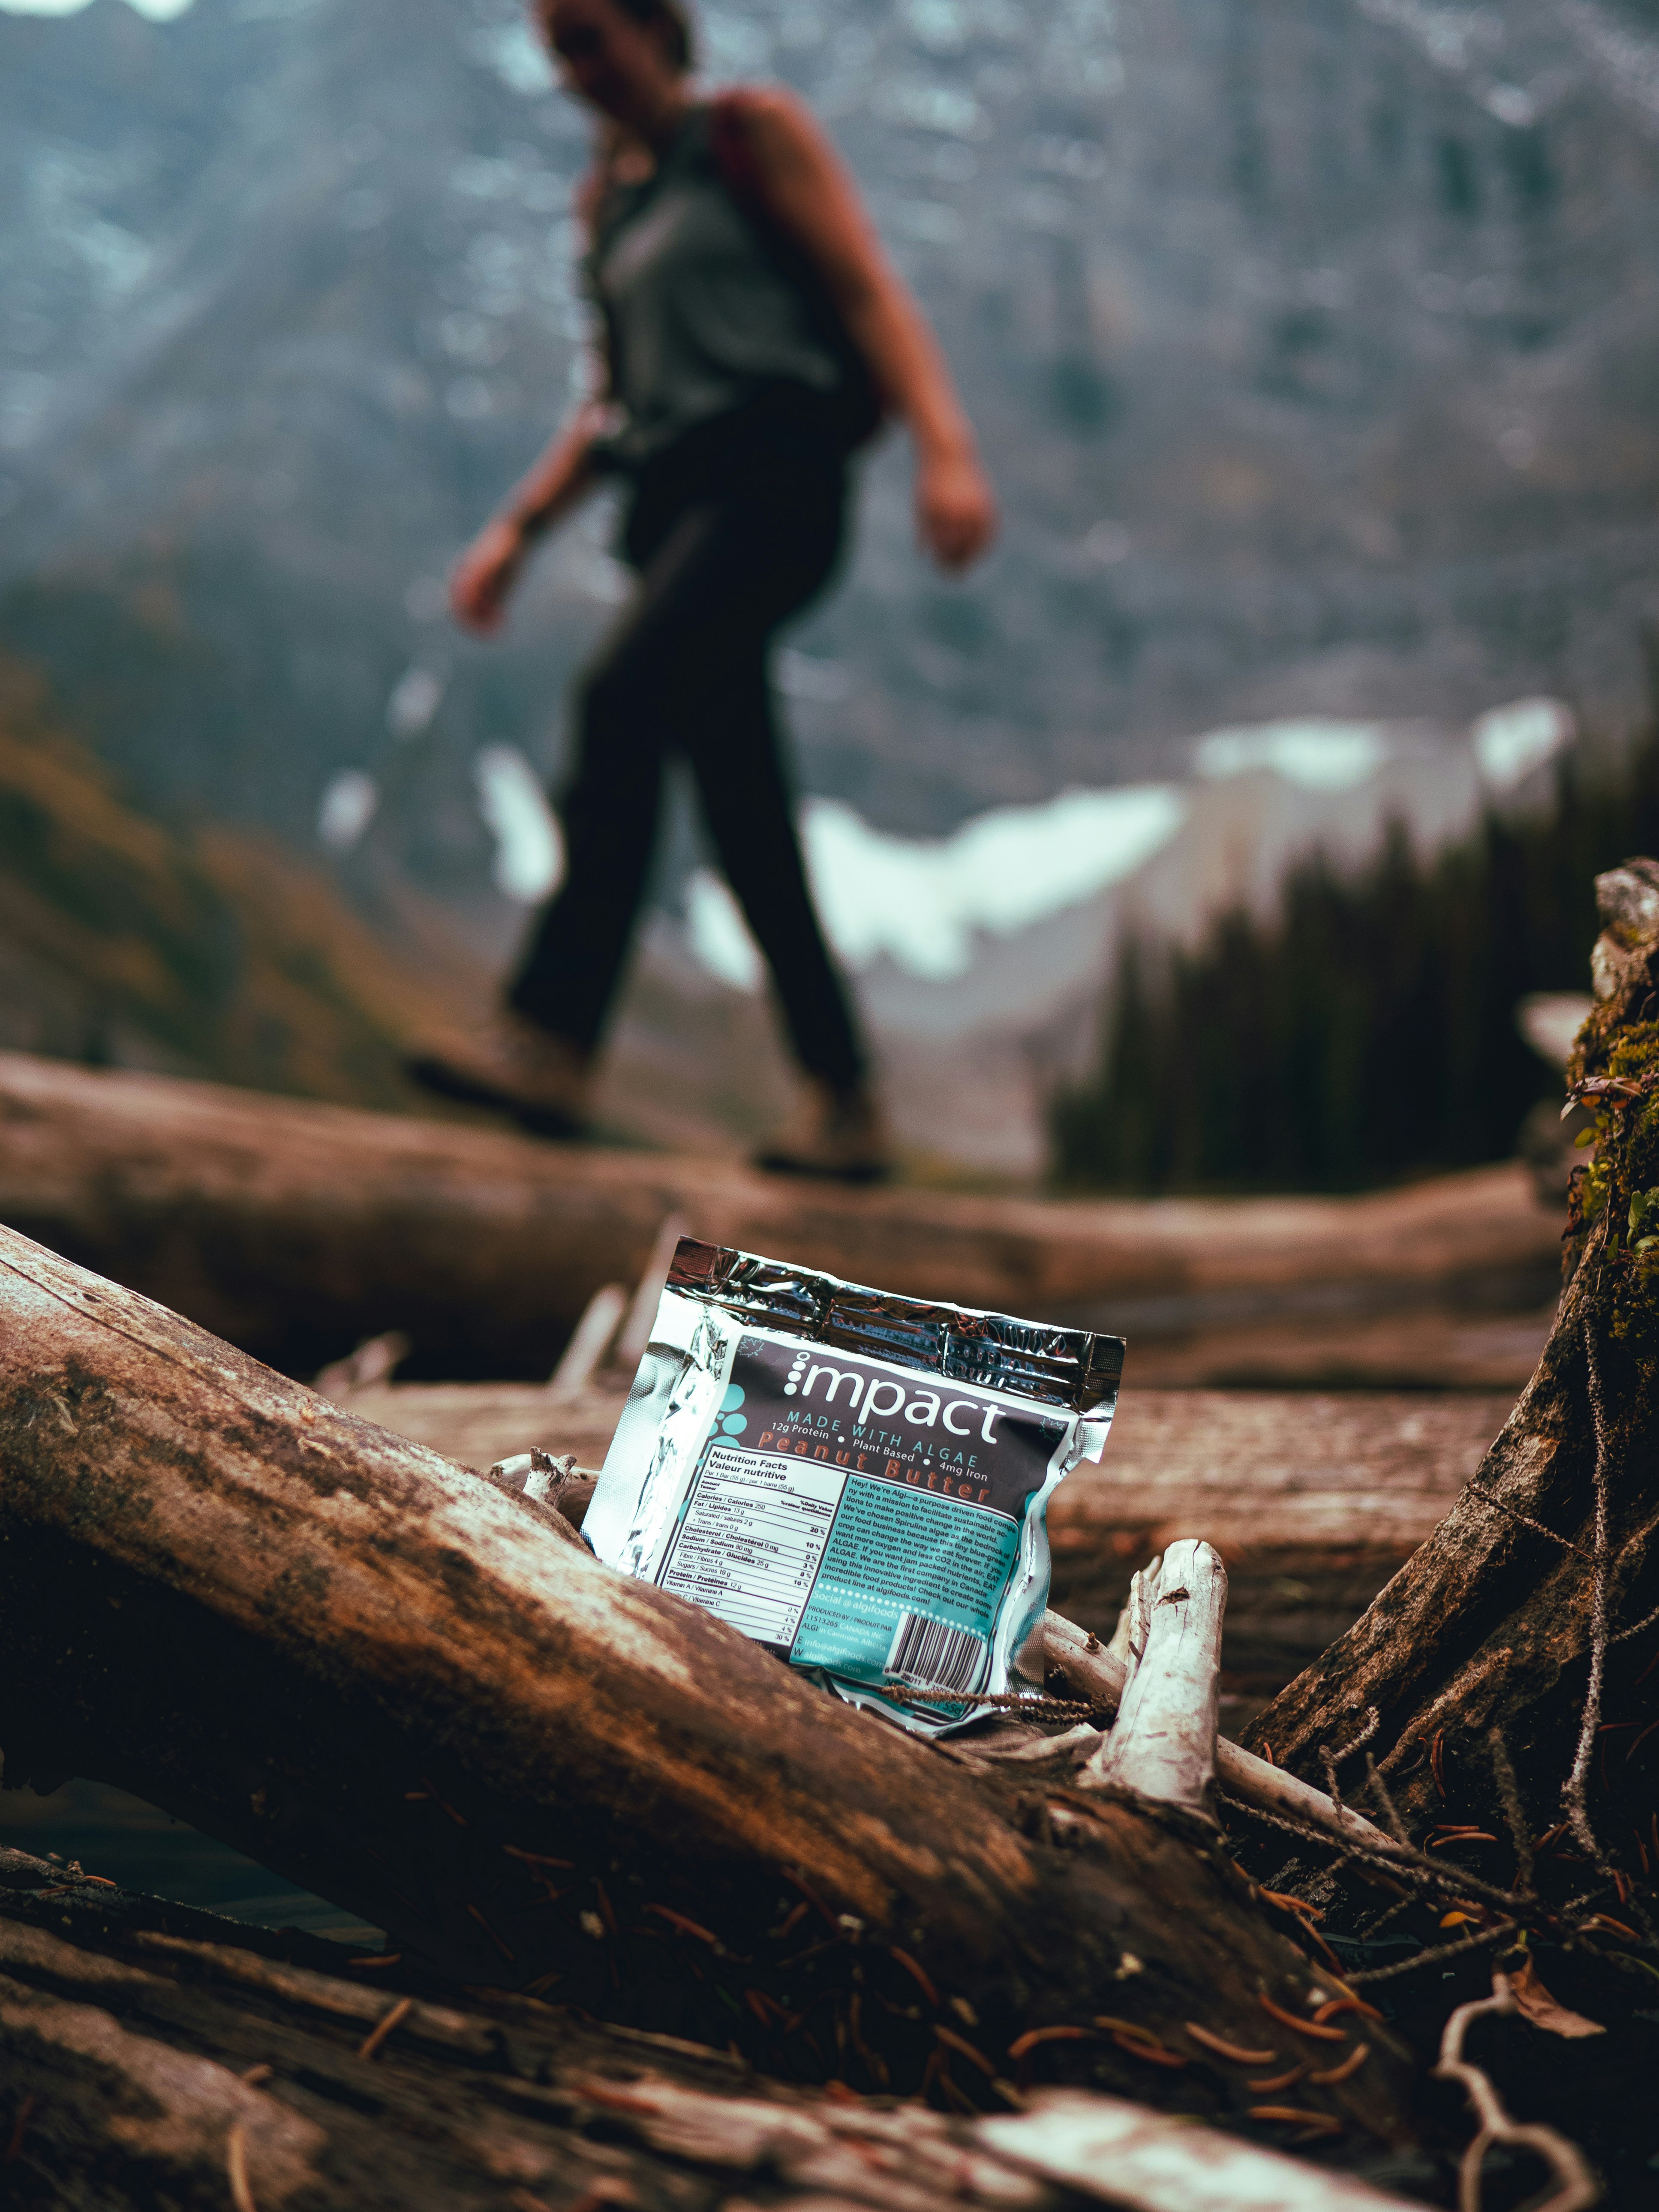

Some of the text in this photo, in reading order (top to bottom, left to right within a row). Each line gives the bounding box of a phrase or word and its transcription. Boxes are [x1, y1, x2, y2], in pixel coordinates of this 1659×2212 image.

[784, 1351, 1006, 1443] impact
[772, 1422, 988, 1481] 12g Protein Plant Based 4mg Iron
[787, 1411, 977, 1467] MADE WITH ALGAE
[710, 1460, 786, 1480] Valeur nutritive
[712, 1451, 787, 1470] Nutrition Facts
[758, 1431, 990, 1502] Peanut Butter
[697, 1492, 722, 1501] Calories
[727, 1498, 753, 1507] Calories
[708, 1503, 731, 1512] Lipides
[851, 1478, 868, 1488] Hey!
[870, 1483, 890, 1494] We're
[919, 1498, 950, 1510] purpose
[951, 1506, 974, 1517] driven
[976, 1512, 992, 1523] food
[844, 1503, 865, 1515] We've
[866, 1511, 893, 1522] chosen
[895, 1517, 927, 1531] Spirulina
[929, 1527, 949, 1537] algae
[961, 1535, 973, 1544] the
[974, 1539, 1003, 1557] bedrock
[846, 1495, 864, 1505] tions
[874, 1504, 894, 1513] make
[895, 1509, 924, 1521] positive
[926, 1517, 953, 1529] change
[962, 1527, 974, 1535] the
[976, 1531, 997, 1544] world.
[859, 1491, 874, 1499] with
[882, 1497, 910, 1508] mission
[920, 1506, 952, 1520] facilitate
[953, 1516, 995, 1533] sustainable
[996, 1530, 1007, 1540] ac-
[682, 1534, 734, 1548] Sodium Sodium
[685, 1526, 721, 1536] Cholesterol
[854, 1516, 872, 1526] food
[872, 1520, 905, 1534] business
[906, 1530, 938, 1543] because
[939, 1539, 953, 1547] this
[954, 1542, 968, 1553] tiny
[969, 1547, 1005, 1567] blue-green
[679, 1542, 755, 1563] Carbohydrate Glucides
[697, 1555, 713, 1563] Fibres
[836, 1530, 853, 1539] want
[854, 1536, 874, 1545] more
[875, 1541, 901, 1552] oxygen
[918, 1551, 933, 1560] less
[935, 1555, 951, 1565] CO2
[952, 1560, 959, 1568] in
[960, 1563, 972, 1572] the
[986, 1572, 1000, 1584] EAT
[838, 1522, 855, 1531] crop
[871, 1530, 899, 1542] change
[900, 1537, 912, 1546] the
[914, 1542, 928, 1551] way
[955, 1552, 982, 1566] forever.
[990, 1566, 1002, 1576] you
[669, 1569, 692, 1578] Protein
[676, 1561, 717, 1573] Sugars Sucres
[830, 1546, 857, 1559] ALGAE.
[860, 1554, 871, 1562] We
[887, 1561, 899, 1569] the
[900, 1564, 915, 1574] first
[916, 1570, 950, 1584] company
[959, 1582, 987, 1598] Canada
[832, 1538, 860, 1550] ALGAE.
[885, 1553, 903, 1562] want
[902, 1556, 917, 1565] jam
[918, 1562, 946, 1572] packed
[983, 1581, 996, 1592] EAT
[666, 1579, 717, 1594] Vitamin Vitamine
[813, 1590, 842, 1605] Social
[821, 1573, 851, 1584] product
[852, 1579, 866, 1588] line
[875, 1587, 930, 1605] algifoods.com!
[824, 1563, 990, 1619] incredible food products! Check out our whole
[827, 1556, 847, 1566] using
[849, 1560, 863, 1569] this
[864, 1564, 901, 1579] innovative
[902, 1574, 941, 1590] ingredient
[950, 1590, 974, 1602] create
[975, 1598, 992, 1611] some
[802, 1622, 818, 1631] ALGI
[806, 1614, 884, 1641] 11513265 CANADA INC.
[808, 1605, 841, 1617] PRODUCED
[853, 1617, 880, 1628] PRODUIT
[901, 1672, 921, 1686] 28011
